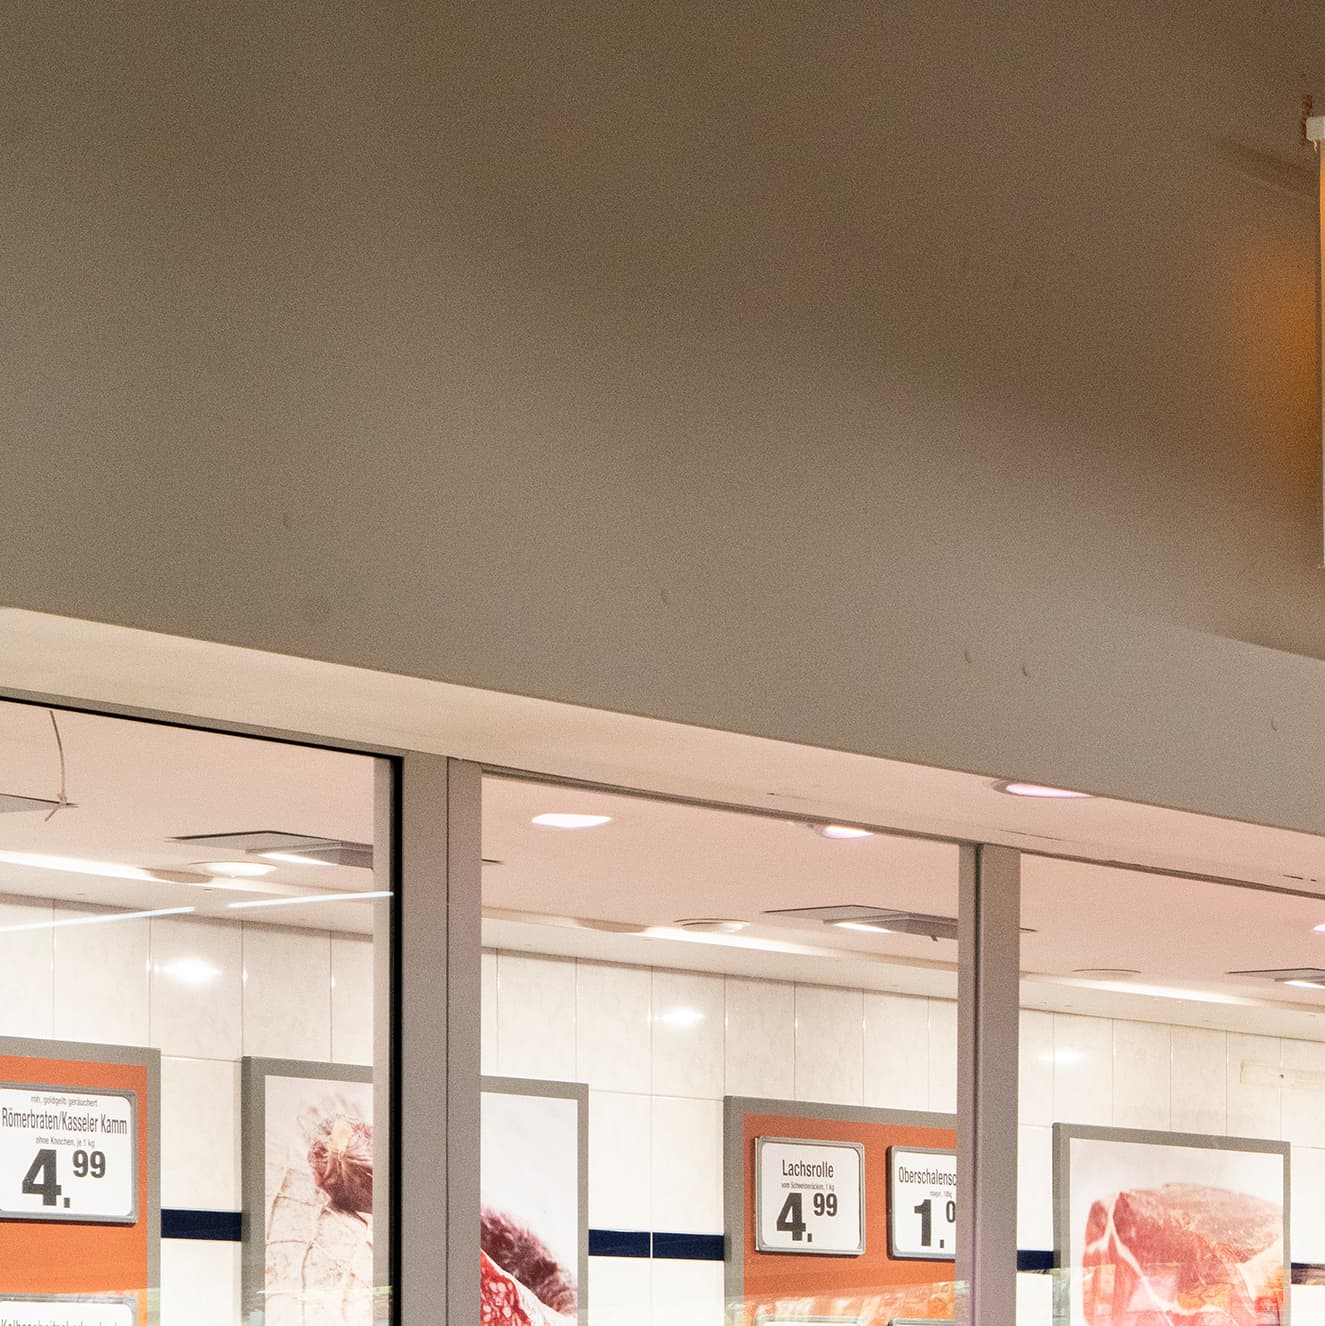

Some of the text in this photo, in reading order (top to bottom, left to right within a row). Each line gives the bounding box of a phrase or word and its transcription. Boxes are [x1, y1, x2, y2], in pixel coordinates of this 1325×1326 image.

[2, 1107, 128, 1135] Römerbraten/Kasseler Kamm
[781, 1160, 834, 1178] Lachsrolle
